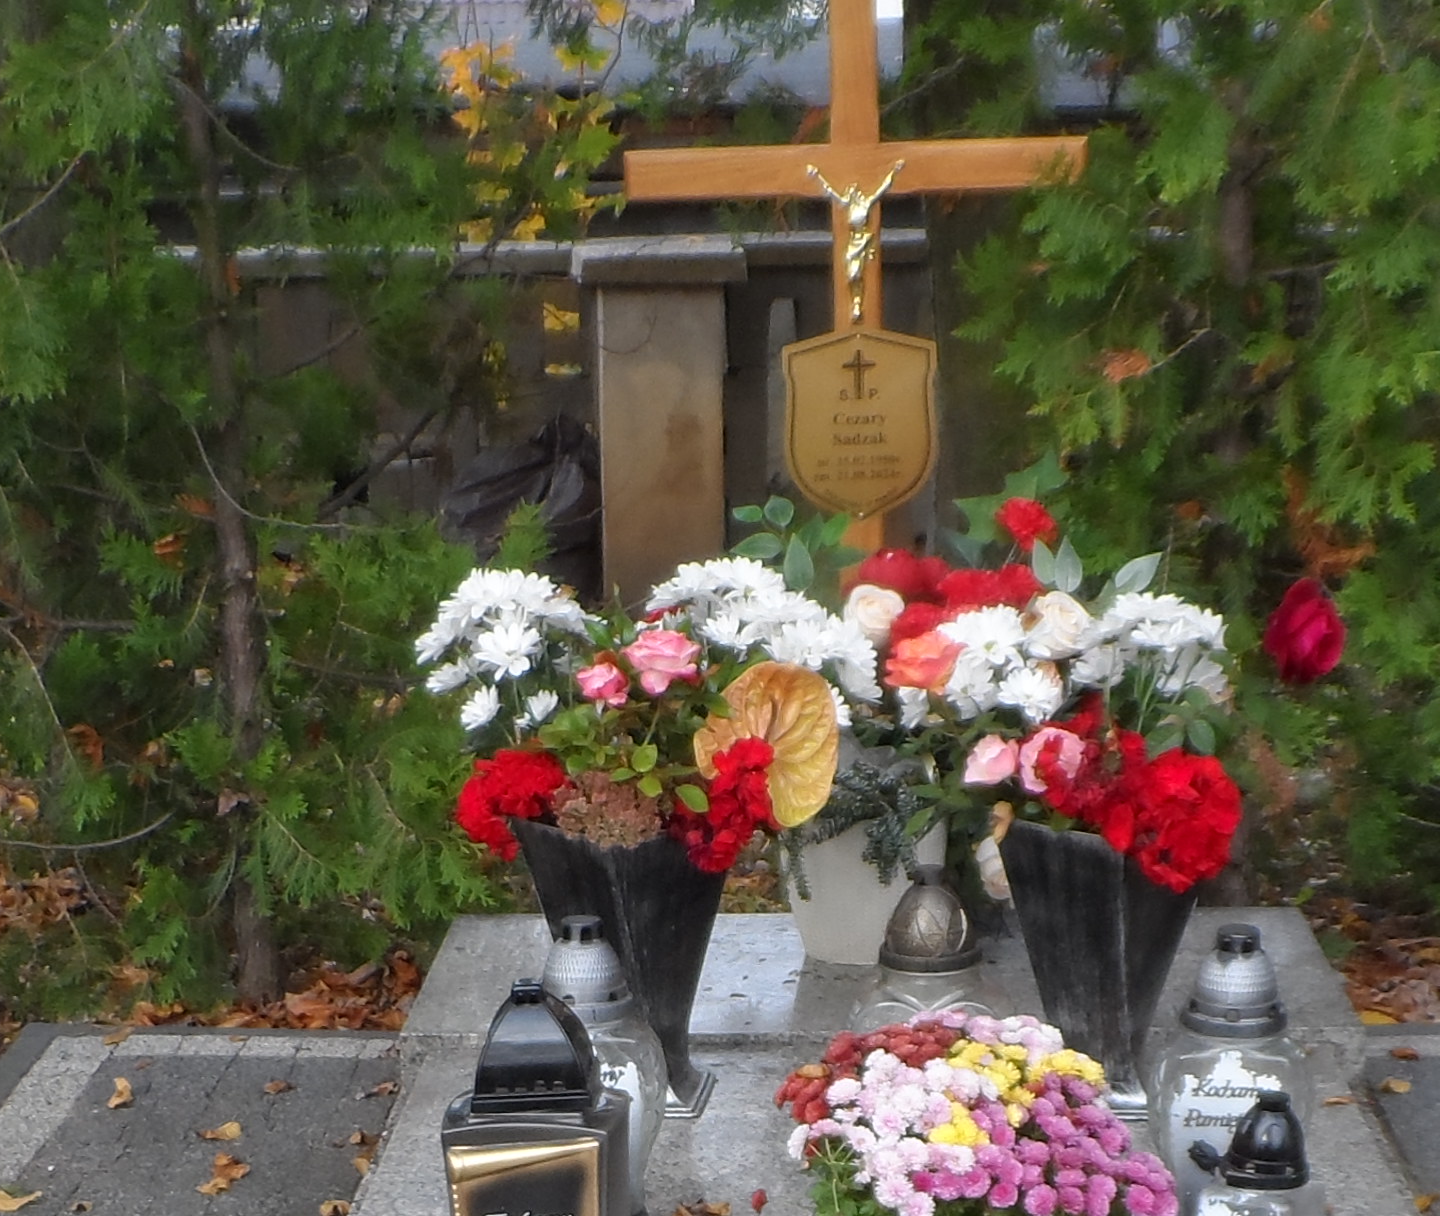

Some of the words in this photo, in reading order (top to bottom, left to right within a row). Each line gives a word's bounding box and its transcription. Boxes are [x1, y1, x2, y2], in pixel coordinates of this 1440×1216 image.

[833, 412, 887, 427] Cezary
[1191, 1078, 1264, 1098] Kocham
[1183, 1108, 1247, 1134] Pamię
